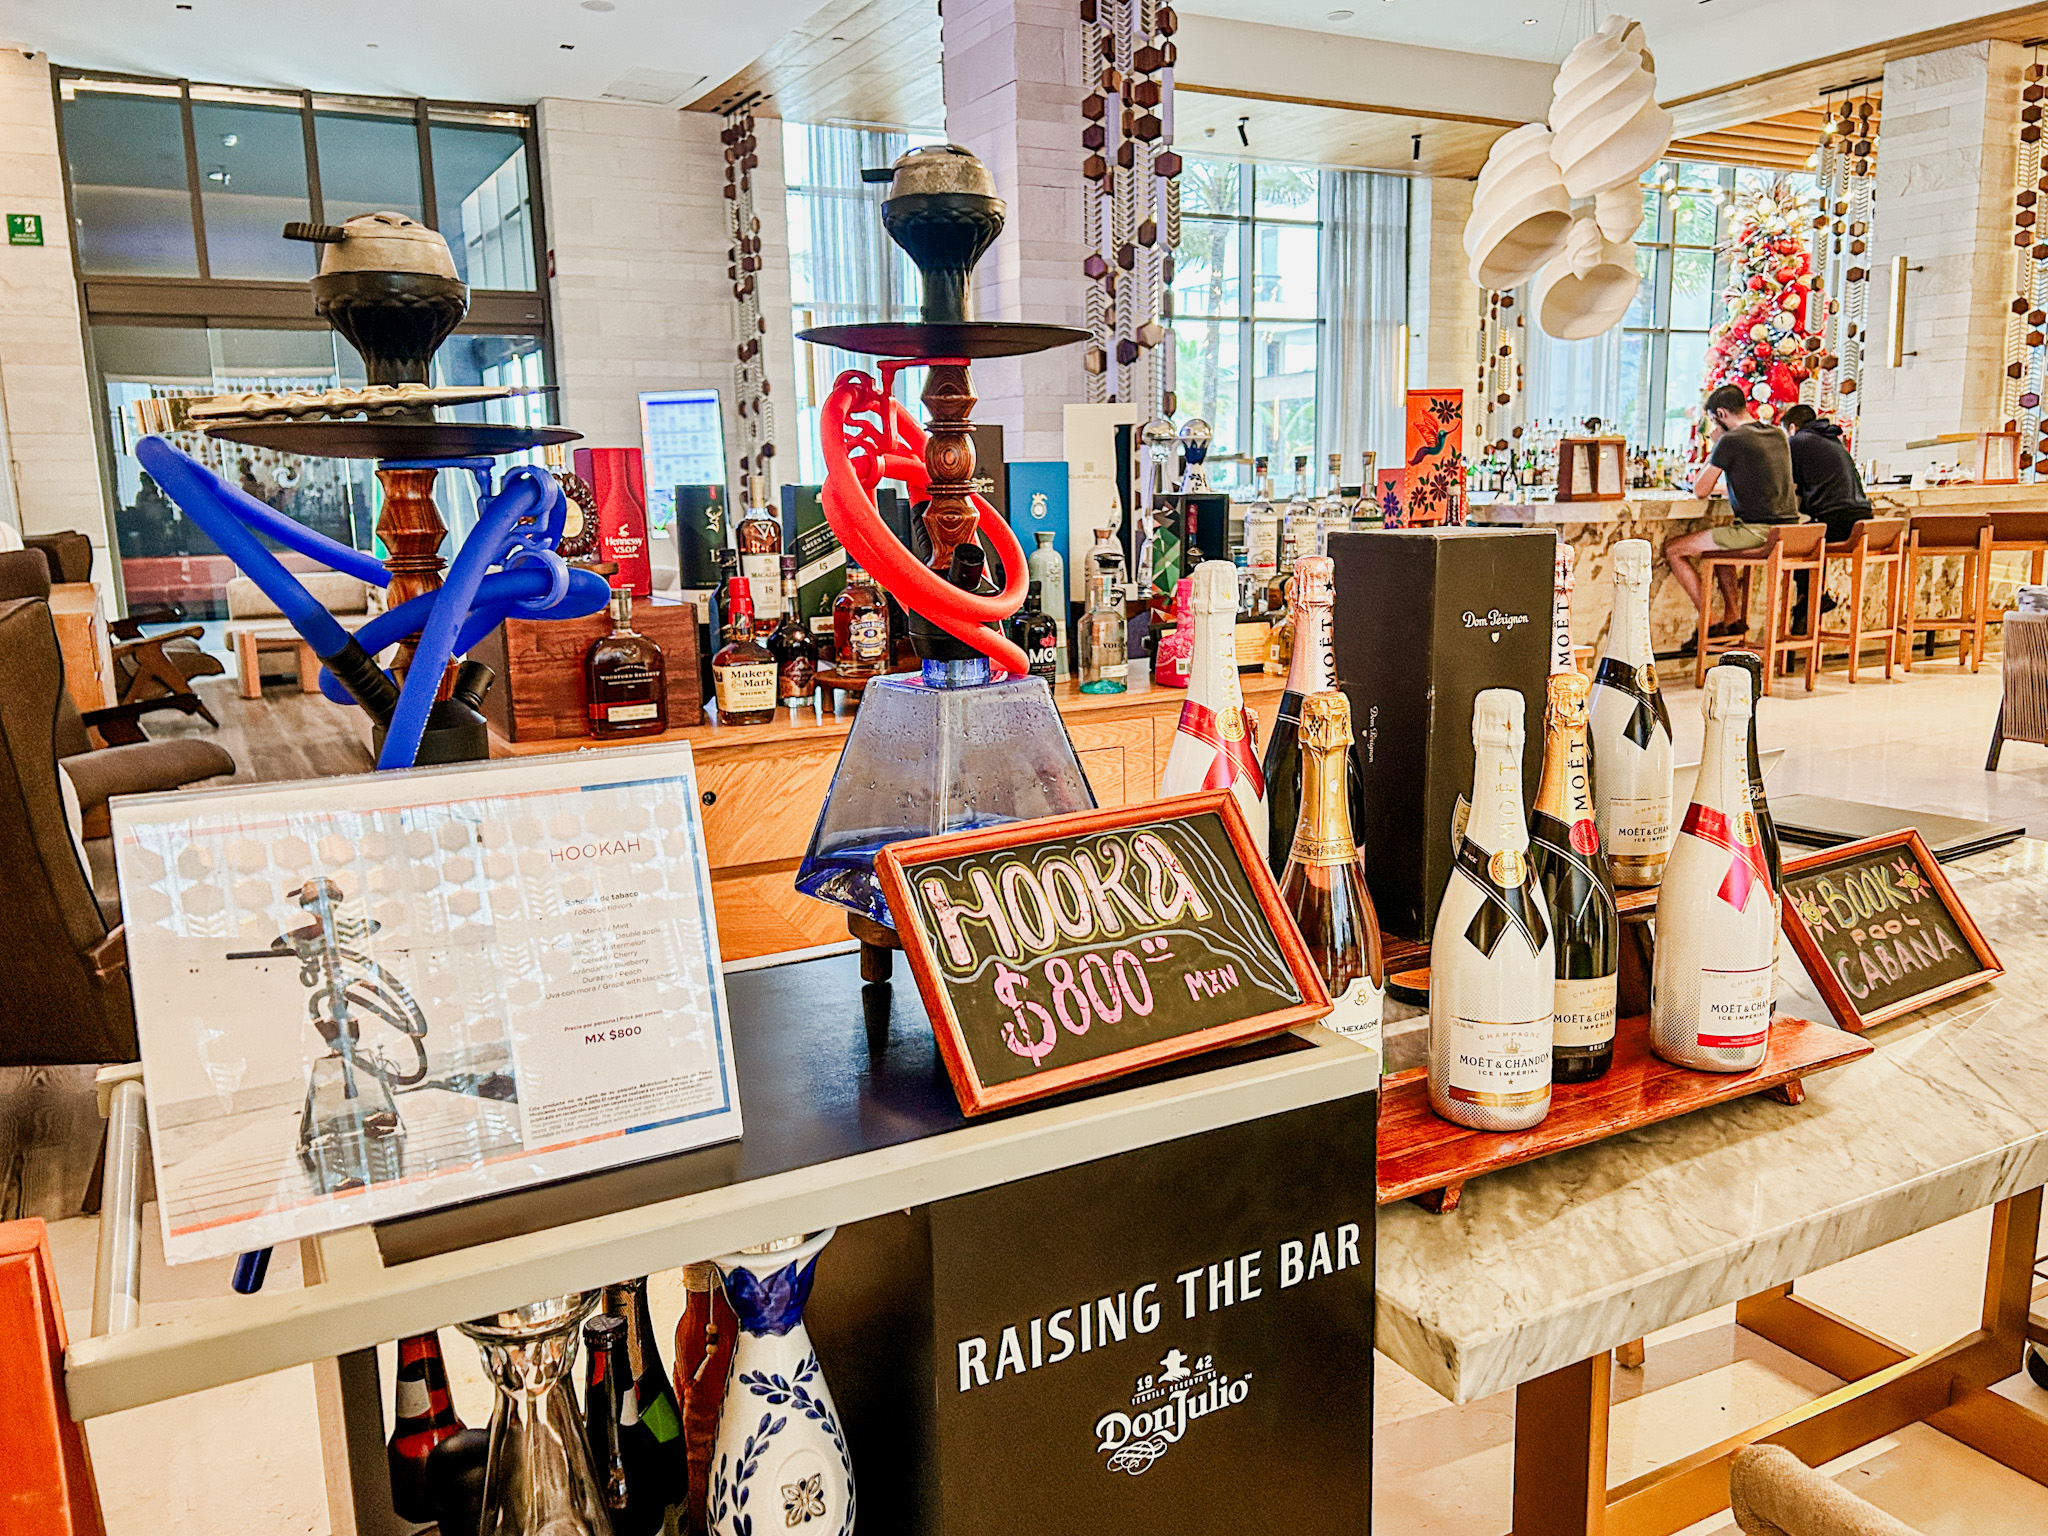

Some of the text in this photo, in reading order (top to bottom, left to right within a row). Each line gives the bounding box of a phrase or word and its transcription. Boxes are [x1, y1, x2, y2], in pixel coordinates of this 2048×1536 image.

[605, 537, 643, 547] Hennessy
[801, 537, 821, 552] GREEN
[819, 562, 828, 571] 15
[764, 586, 773, 594] 18
[1462, 609, 1529, 630] Dom Pérignon
[1554, 602, 1571, 666] MOËT
[1029, 648, 1056, 664] MO
[1319, 618, 1337, 688] MOËT
[730, 669, 774, 680] Maker's
[743, 678, 773, 688] Mark
[1567, 740, 1588, 811] MOËT
[1496, 762, 1517, 840] MOËT
[1618, 827, 1645, 836] MOËT
[549, 838, 641, 863] HOOKAH
[611, 891, 638, 900] tabaco
[1816, 865, 1911, 929] BOOK
[615, 931, 641, 940] Double
[1850, 913, 1921, 947] POOL
[613, 950, 638, 959] Cherry
[1836, 923, 1963, 999] CABANA
[545, 992, 560, 1000] Uva
[576, 986, 596, 994] mora
[602, 981, 624, 990] Grape
[993, 948, 1154, 1067] $800
[1183, 963, 1240, 1002] MXN
[1710, 1003, 1742, 1013] MOËT
[1744, 1005, 1750, 1013] &
[1553, 1014, 1585, 1023] MOËT
[585, 1025, 642, 1045] MX $800
[1479, 1032, 1540, 1041] CHAMPAGNE
[1459, 1054, 1493, 1067] MOËT
[1499, 1068, 1538, 1076] IMPÉRIAL
[957, 1223, 1361, 1393] RAISING THE BAR
[1136, 1354, 1212, 1392] 19 42
[1132, 1388, 1165, 1406] TEQUILA
[1169, 1374, 1204, 1392] RESERVA
